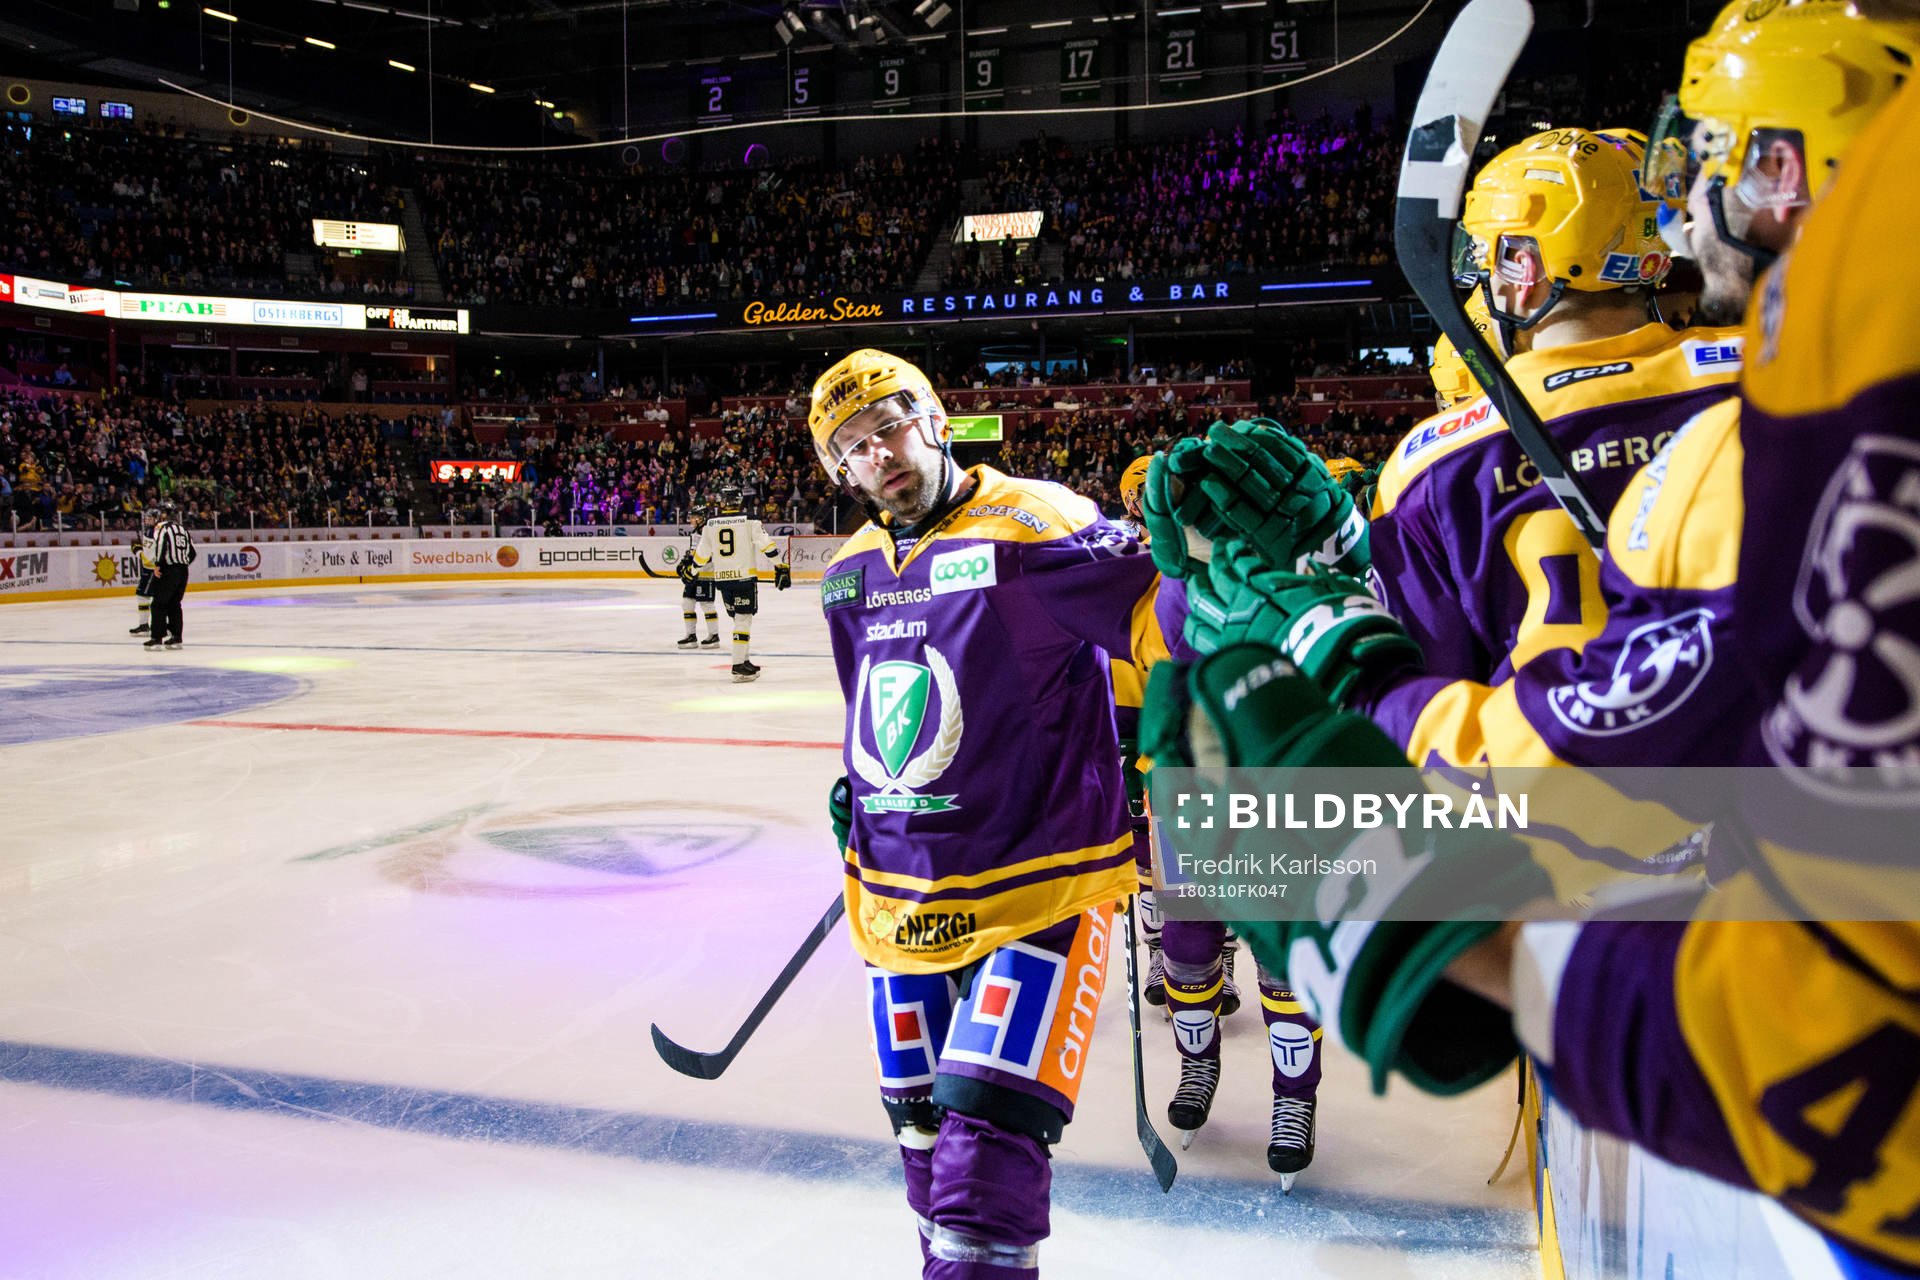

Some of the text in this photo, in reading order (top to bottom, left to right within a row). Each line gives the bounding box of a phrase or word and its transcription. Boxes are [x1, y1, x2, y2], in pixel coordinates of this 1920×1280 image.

[1166, 40, 1196, 69] 21
[1269, 30, 1299, 60] 51
[977, 59, 992, 86] 9
[1068, 50, 1094, 78] 17
[794, 78, 808, 104] 5
[884, 69, 899, 95] 9
[709, 86, 722, 111] 2
[974, 224, 1035, 238] PIZZERIA
[139, 300, 214, 315] PEAB
[902, 282, 1229, 313] RESTAURANG & BAR
[744, 297, 883, 325] Golden Star
[1695, 346, 1742, 365] EL
[1547, 362, 1629, 388] CCM
[1404, 403, 1491, 458] ELON
[175, 535, 186, 548] 85
[718, 528, 735, 557] 9
[208, 552, 249, 568] KMAB
[322, 549, 393, 567] Puts & Tegel
[412, 551, 494, 565] Swedbank
[934, 556, 989, 581] coop
[866, 588, 932, 609] LÖFBERGS
[866, 618, 927, 642] stadium
[895, 912, 977, 946] ENERGI
